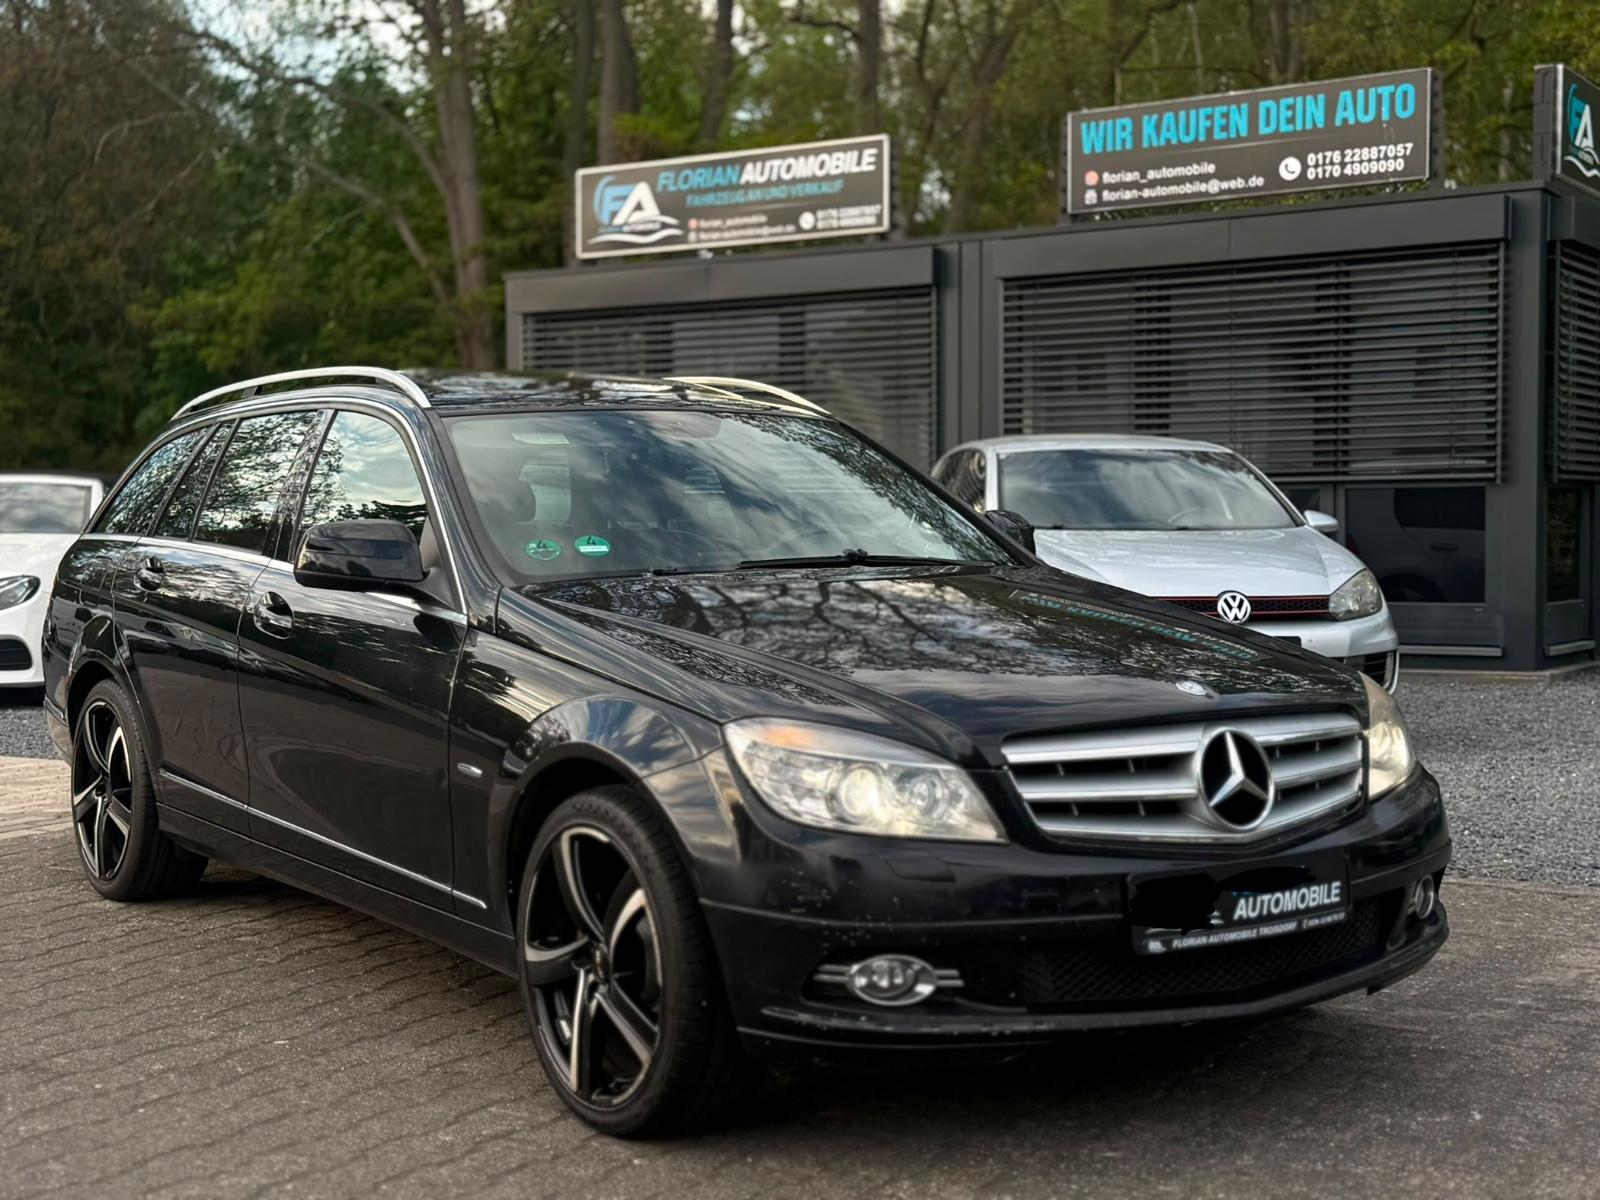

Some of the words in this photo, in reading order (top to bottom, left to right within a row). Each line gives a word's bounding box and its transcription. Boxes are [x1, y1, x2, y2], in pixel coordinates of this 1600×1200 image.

[1080, 117, 1133, 154] WIR
[1142, 103, 1249, 148] KAUFEN
[1258, 94, 1325, 135] DEIN
[1334, 82, 1416, 126] AUTO
[1307, 150, 1342, 167] 0176
[1343, 142, 1414, 163] 22887057
[1102, 161, 1216, 184] florian_automobile
[1307, 165, 1341, 180] 0170
[1233, 881, 1342, 921] AUTOMOBILE
[1172, 936, 1207, 949] FLORIAN
[1208, 928, 1257, 943] AUTOMOBILE
